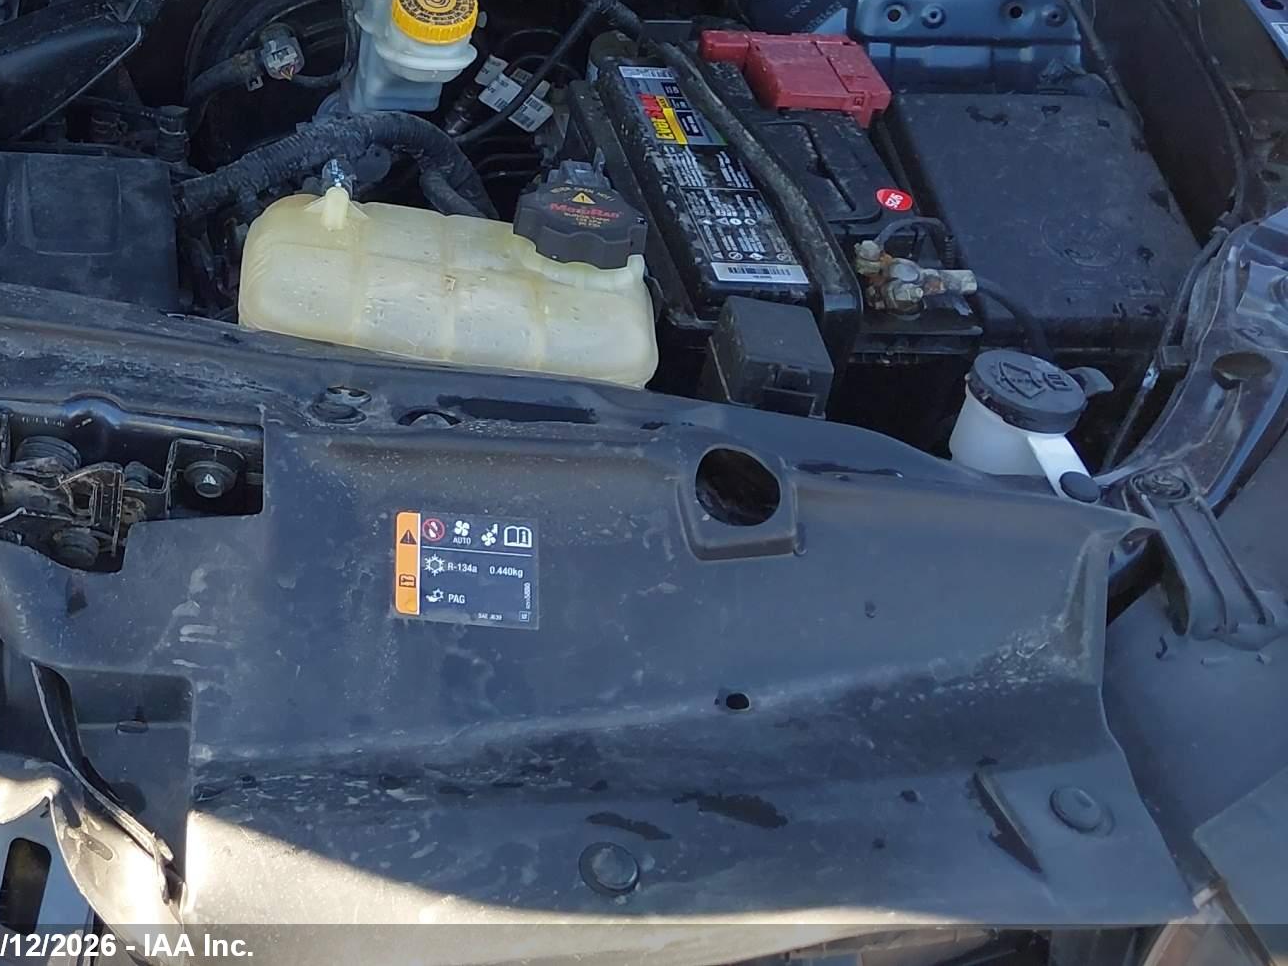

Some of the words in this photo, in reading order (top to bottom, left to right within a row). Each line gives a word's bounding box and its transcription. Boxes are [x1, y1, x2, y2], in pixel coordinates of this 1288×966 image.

[452, 536, 472, 546] AUTO
[447, 562, 478, 573] R-134a
[489, 566, 524, 579] 0.440kg
[448, 593, 466, 604] PAG
